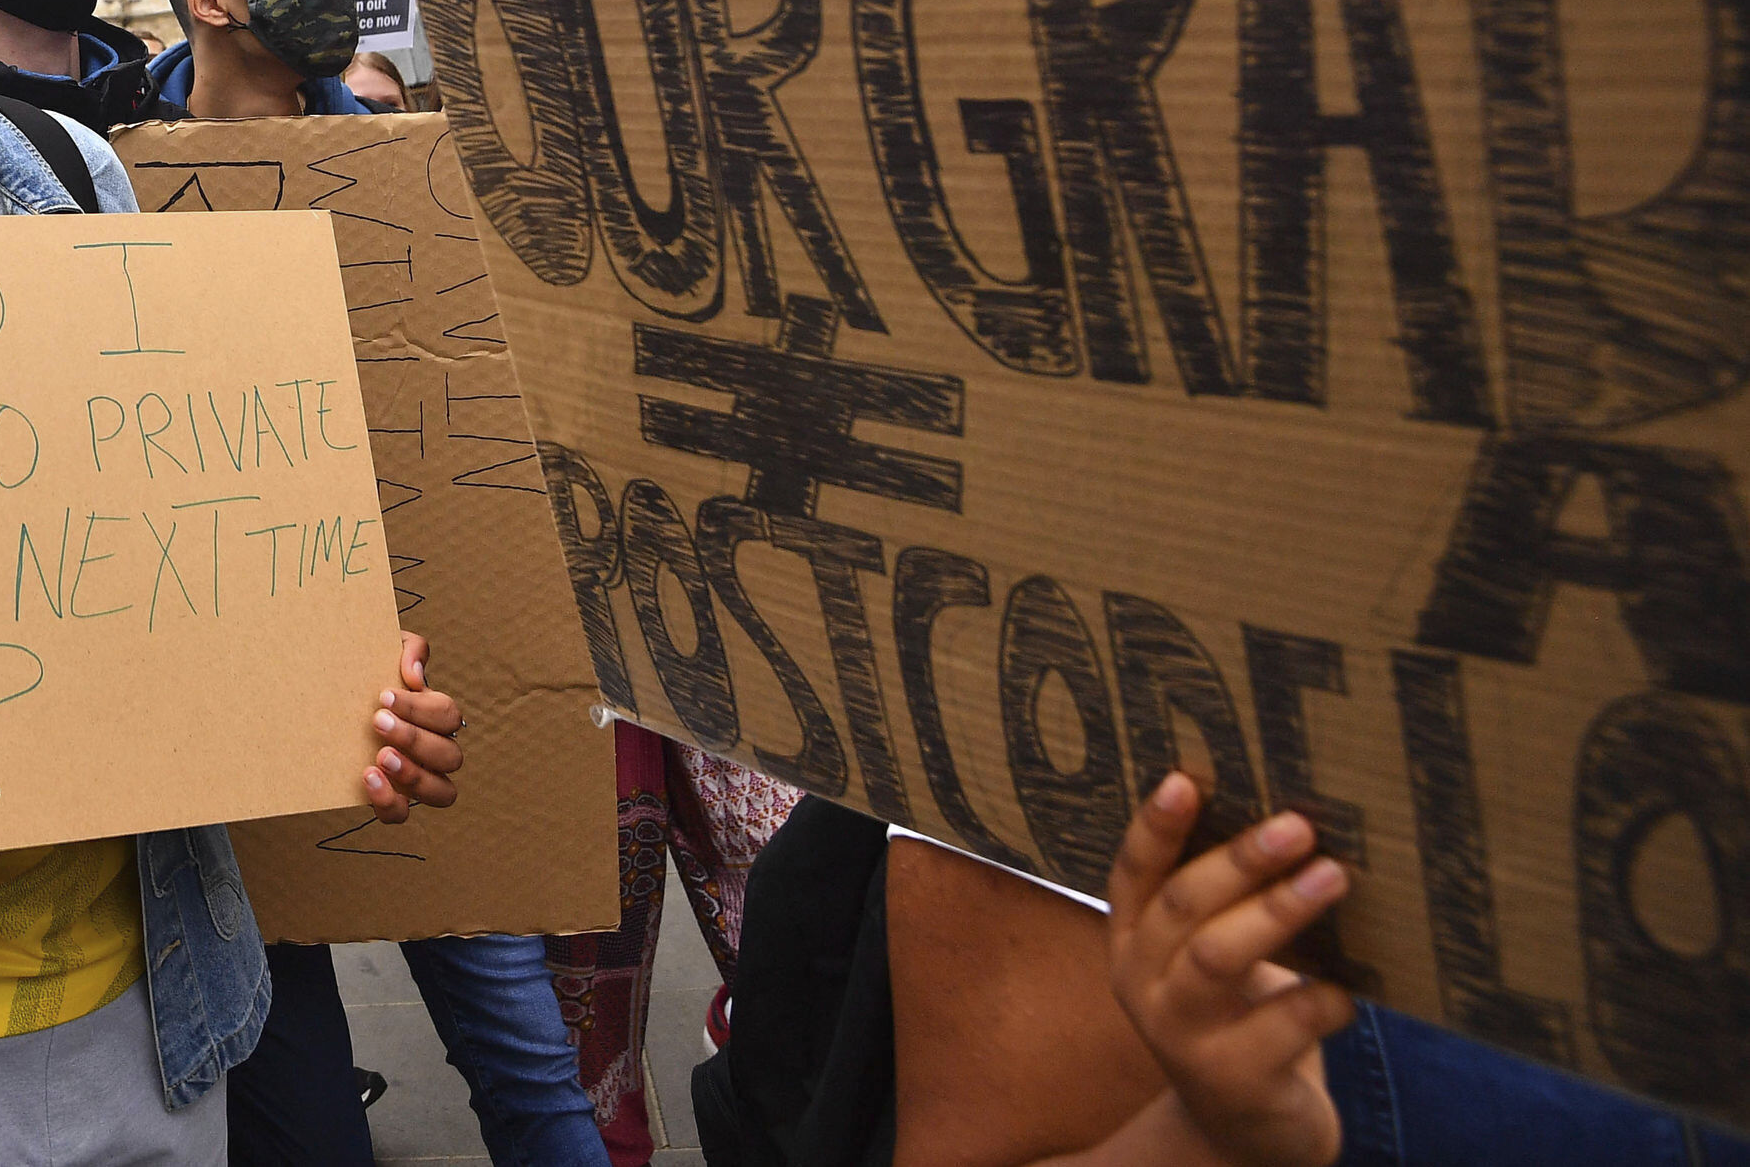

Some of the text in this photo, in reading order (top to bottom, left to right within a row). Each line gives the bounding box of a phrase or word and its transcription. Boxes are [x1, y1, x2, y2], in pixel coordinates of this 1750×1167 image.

[376, 14, 401, 28] now
[74, 242, 186, 356] I
[86, 379, 358, 479] PRIVATE
[15, 496, 261, 633] NEXT
[245, 517, 379, 597] TIME
